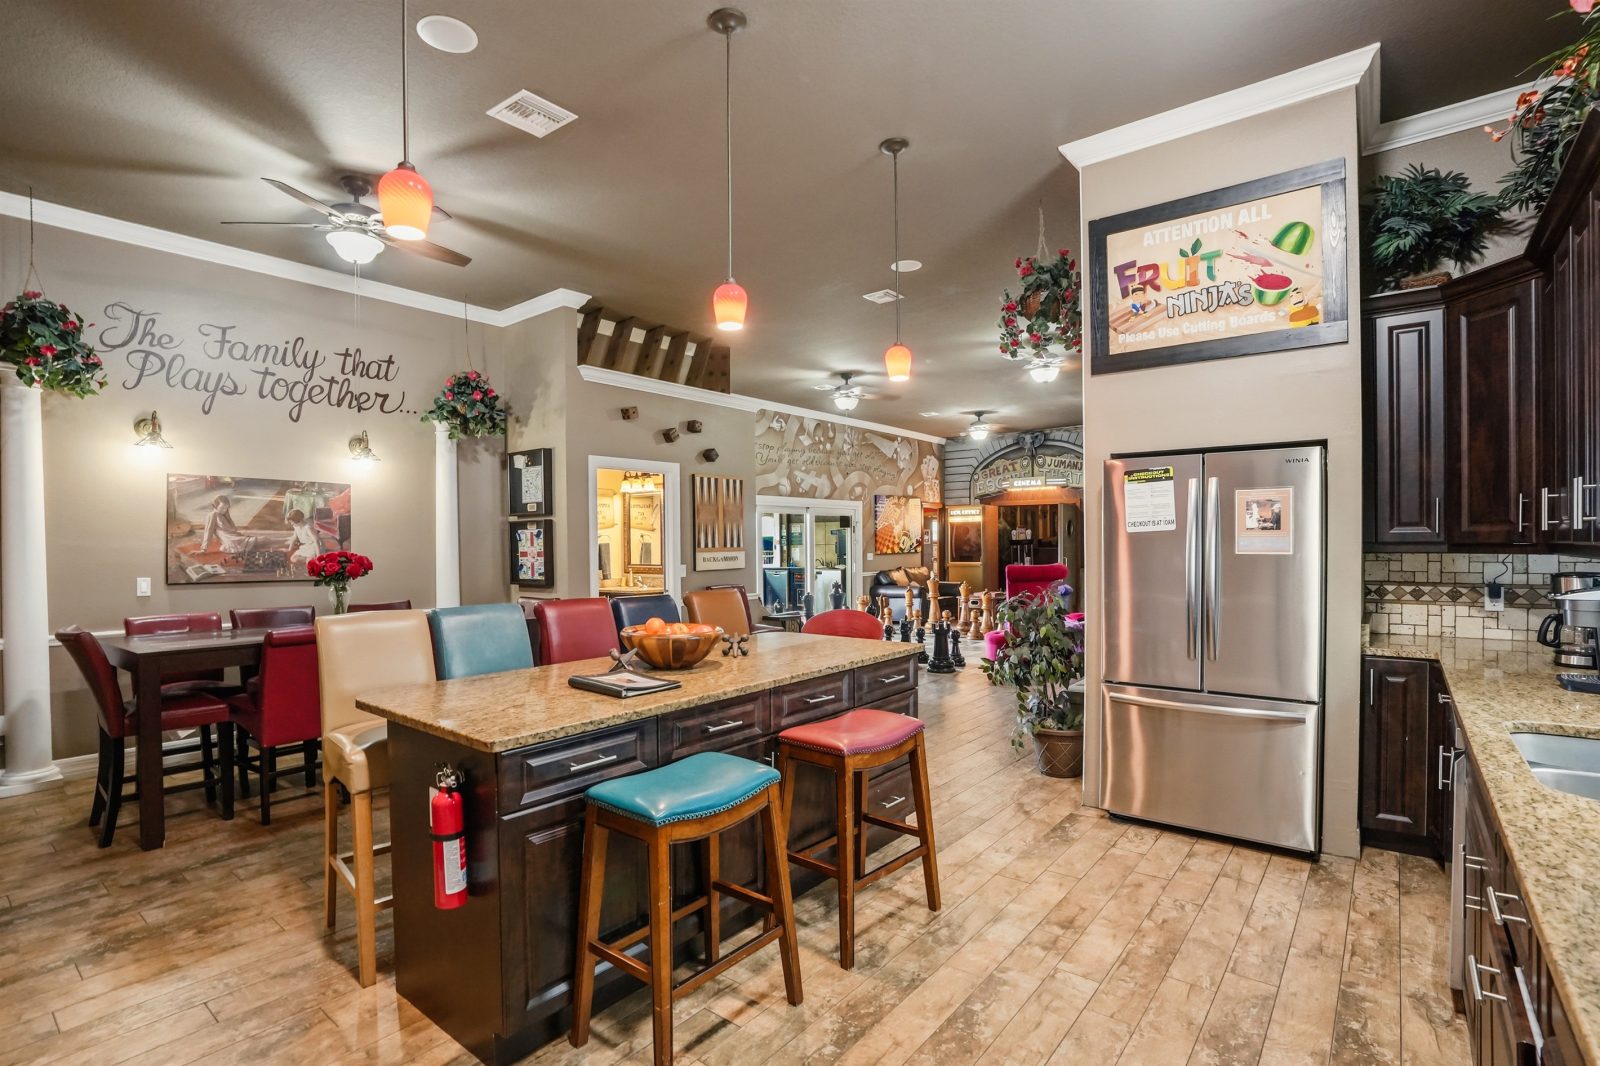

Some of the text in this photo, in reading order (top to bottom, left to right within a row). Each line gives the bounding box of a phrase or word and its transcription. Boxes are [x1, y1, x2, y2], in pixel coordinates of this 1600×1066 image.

[1143, 204, 1272, 247] ATTENTION ALL
[1113, 248, 1224, 300] FRUIT
[1166, 280, 1255, 319] NINJA'S
[1118, 310, 1276, 345] Please Use Cutting Boards
[98, 301, 400, 383] The Family that
[122, 349, 248, 415] Plays
[981, 461, 1019, 480] GREAT
[1040, 467, 1083, 485] THEAT
[1047, 458, 1083, 471] JUMANJ
[976, 471, 1030, 492] ESC
[1013, 479, 1042, 487] CINEMA
[1127, 520, 1151, 528] CHECKOUT
